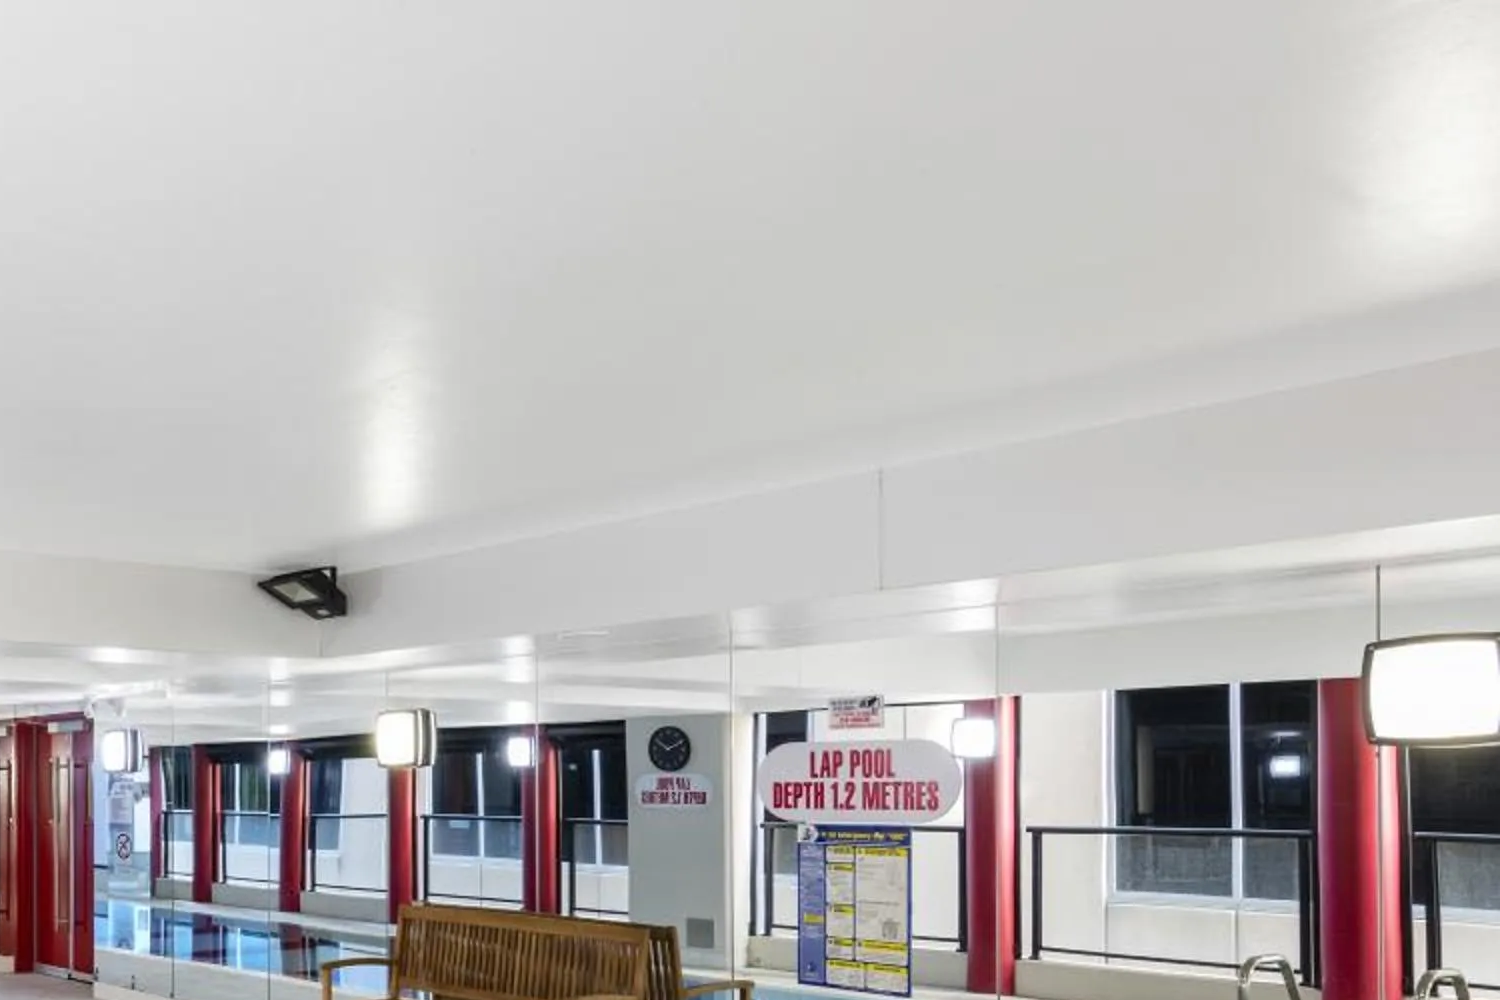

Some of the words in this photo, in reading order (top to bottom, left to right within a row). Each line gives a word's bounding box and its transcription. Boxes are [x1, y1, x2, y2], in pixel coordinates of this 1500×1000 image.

[809, 750, 843, 779] LAP
[850, 748, 895, 779] POOL
[773, 780, 825, 810] DEPTH
[830, 780, 856, 810] 1.2
[862, 780, 940, 812] METRES
